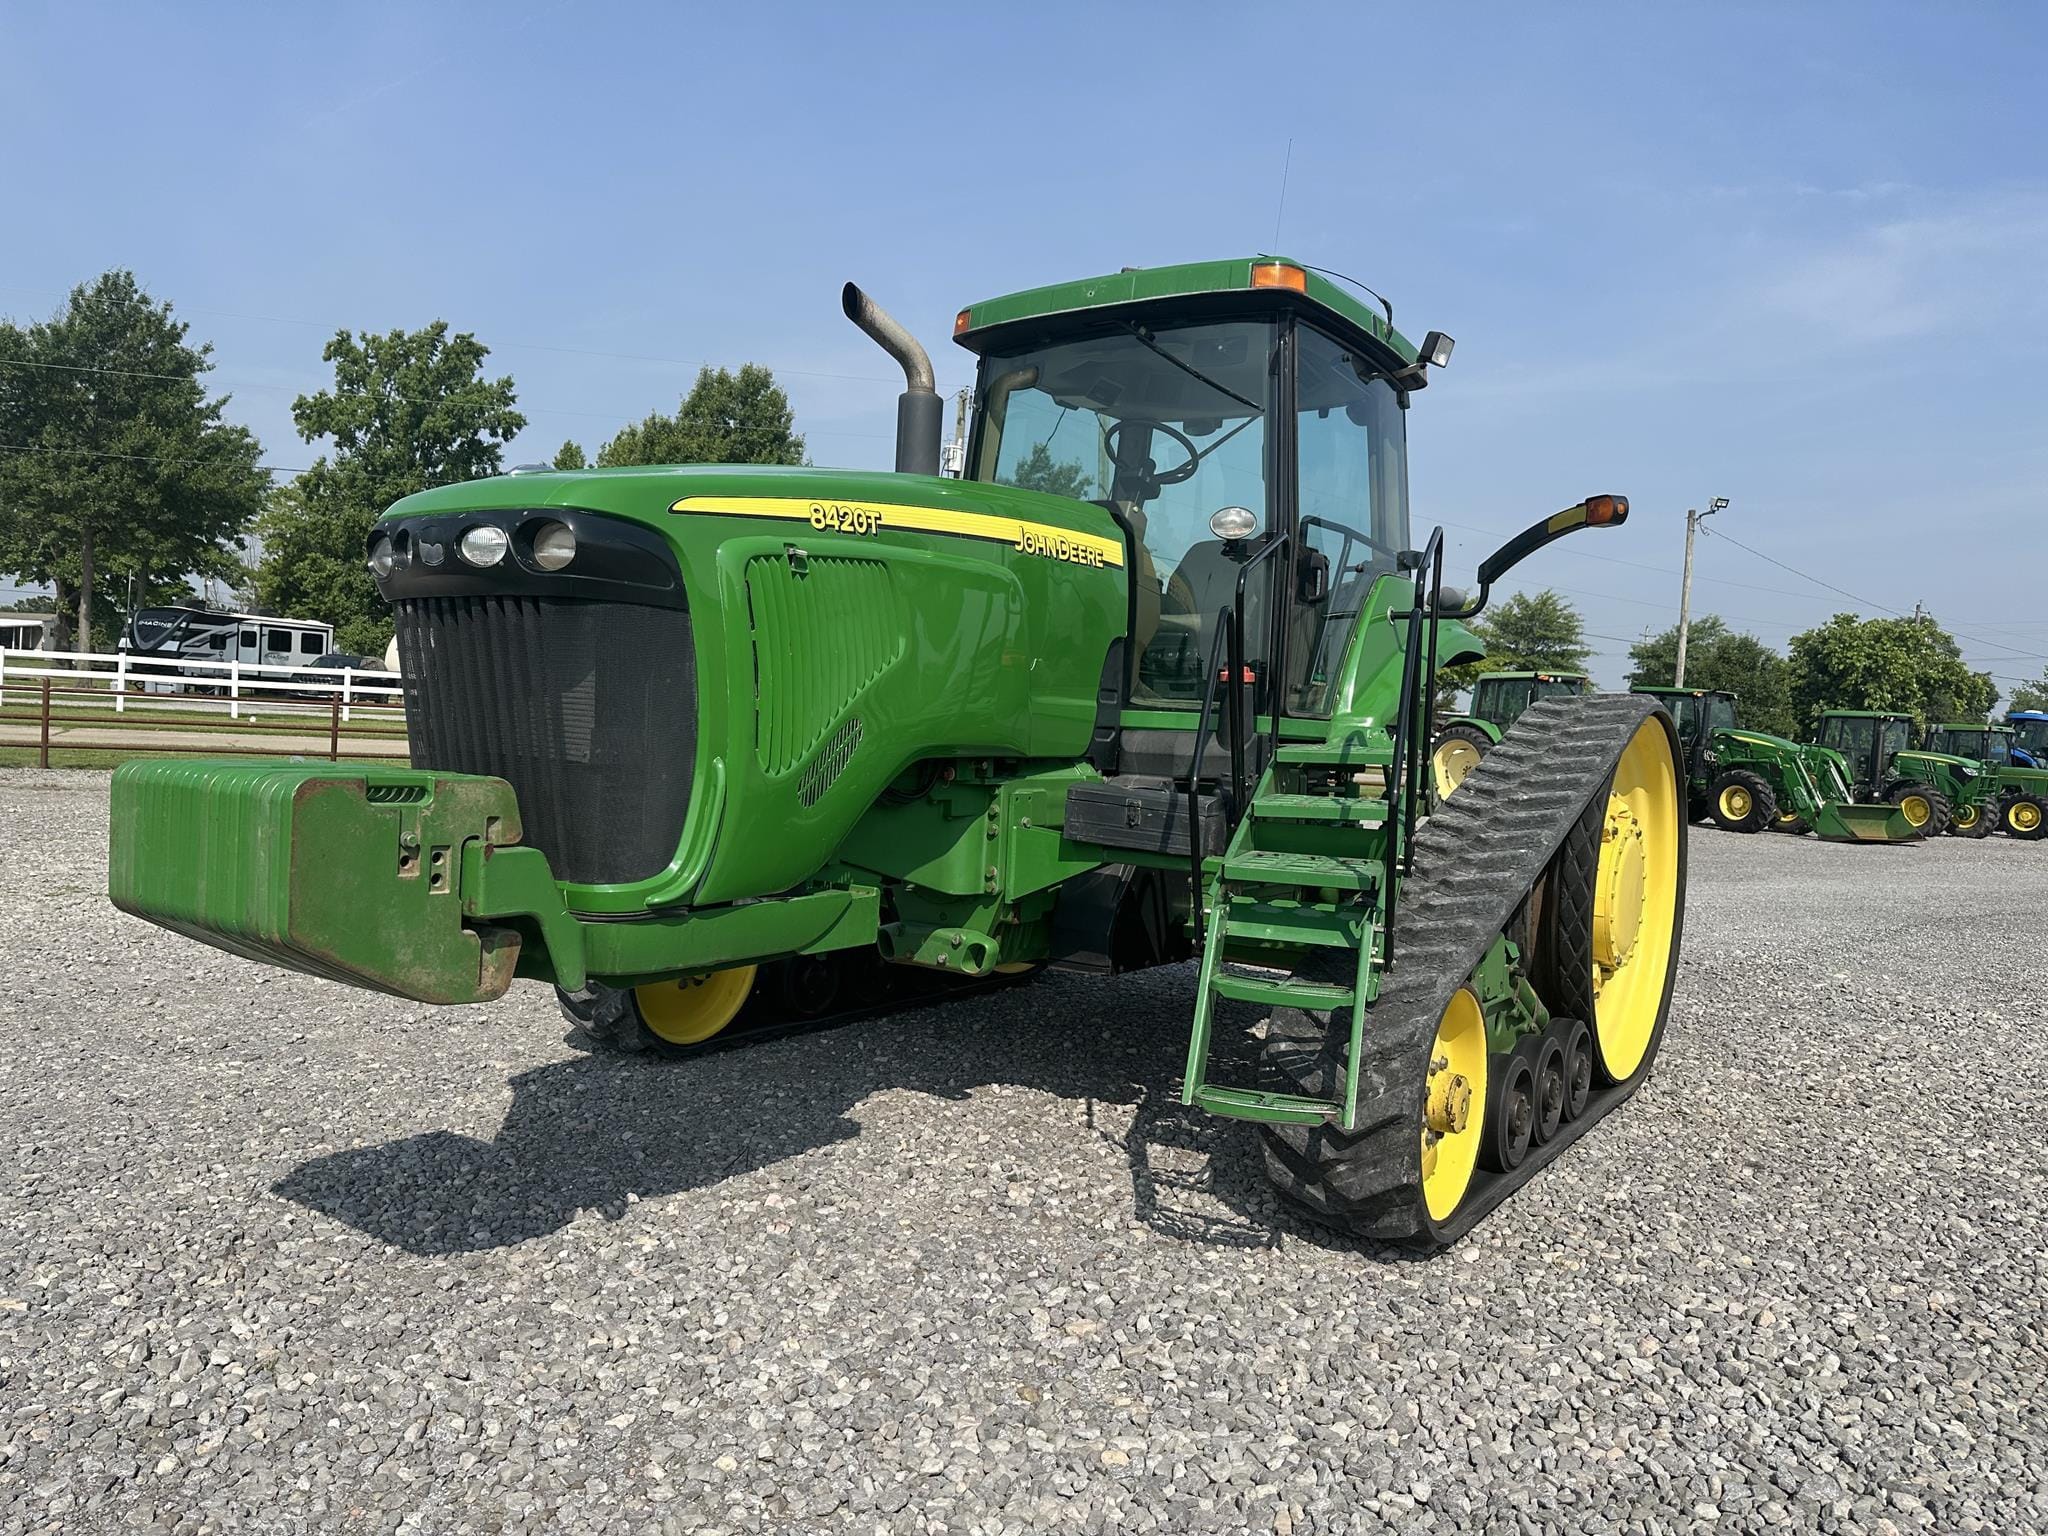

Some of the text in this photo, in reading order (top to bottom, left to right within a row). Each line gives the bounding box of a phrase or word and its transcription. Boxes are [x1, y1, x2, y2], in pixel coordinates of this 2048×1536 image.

[809, 503, 881, 536] 8420T
[1014, 526, 1104, 569] JOHN DEERE
